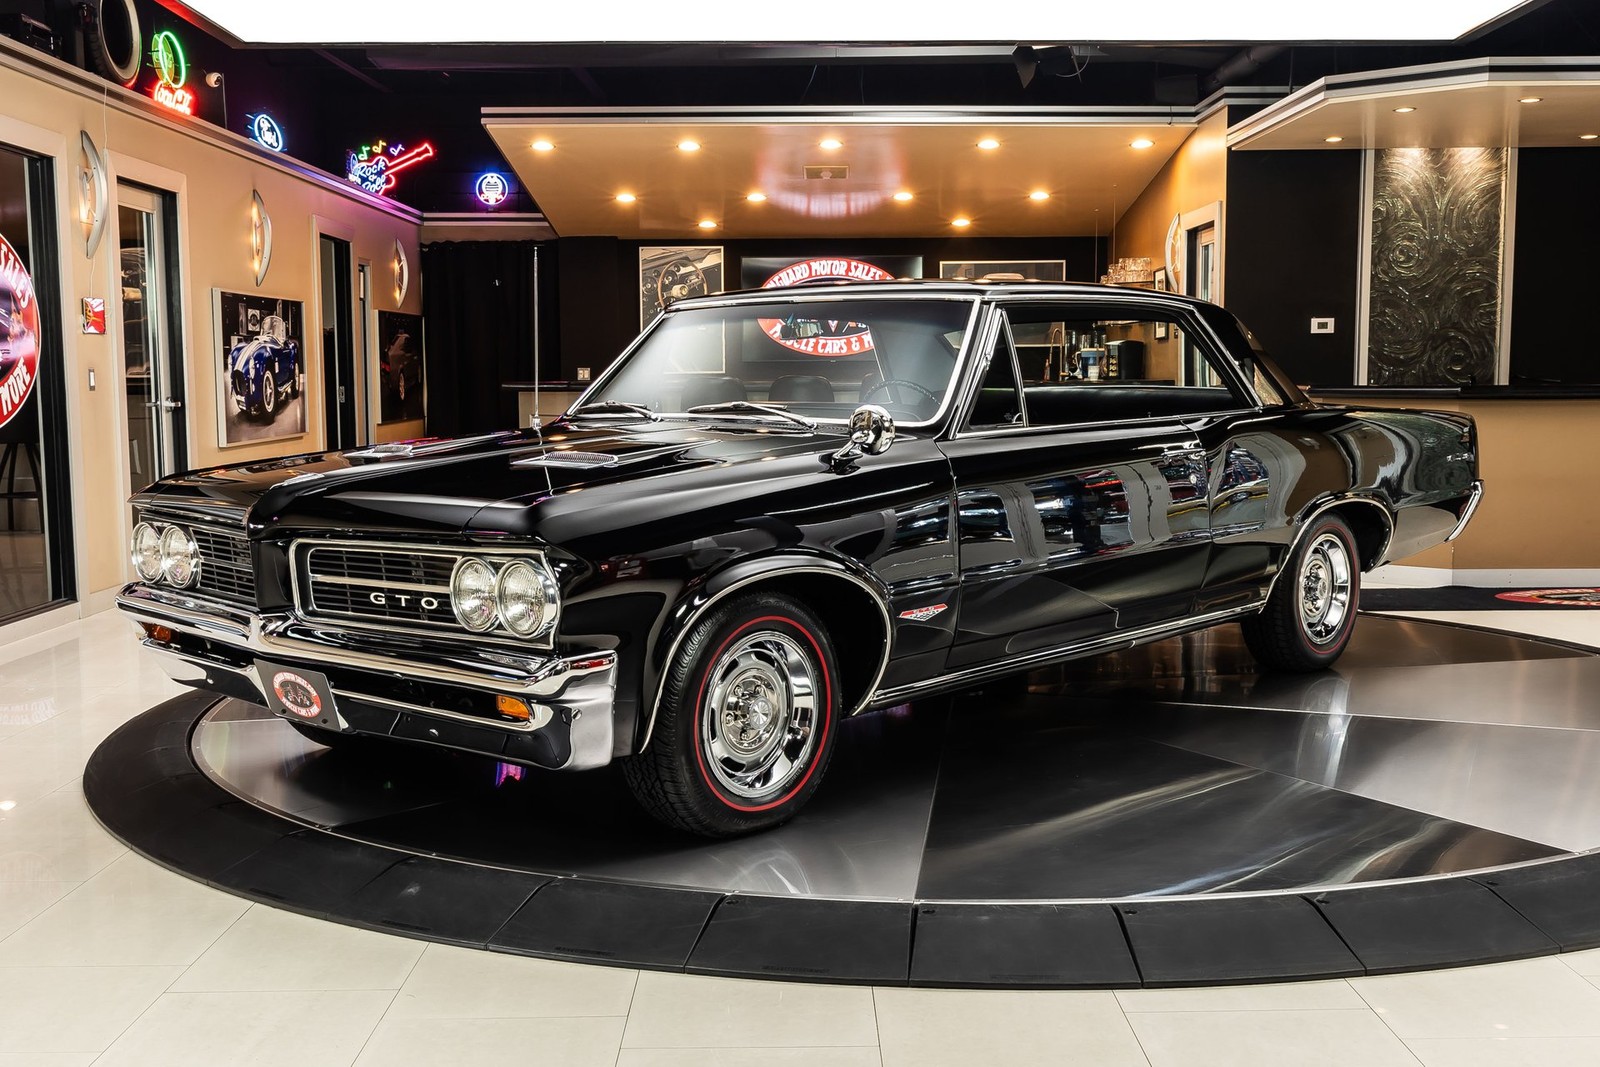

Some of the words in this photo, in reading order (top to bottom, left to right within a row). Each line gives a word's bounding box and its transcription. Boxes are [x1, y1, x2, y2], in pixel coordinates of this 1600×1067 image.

[359, 157, 386, 178] Rock
[0, 243, 33, 309] SALES
[810, 259, 848, 277] MOTOR
[849, 261, 884, 281] SALES
[817, 338, 848, 354] CARS
[0, 356, 32, 416] MORE
[369, 592, 438, 610] GTO
